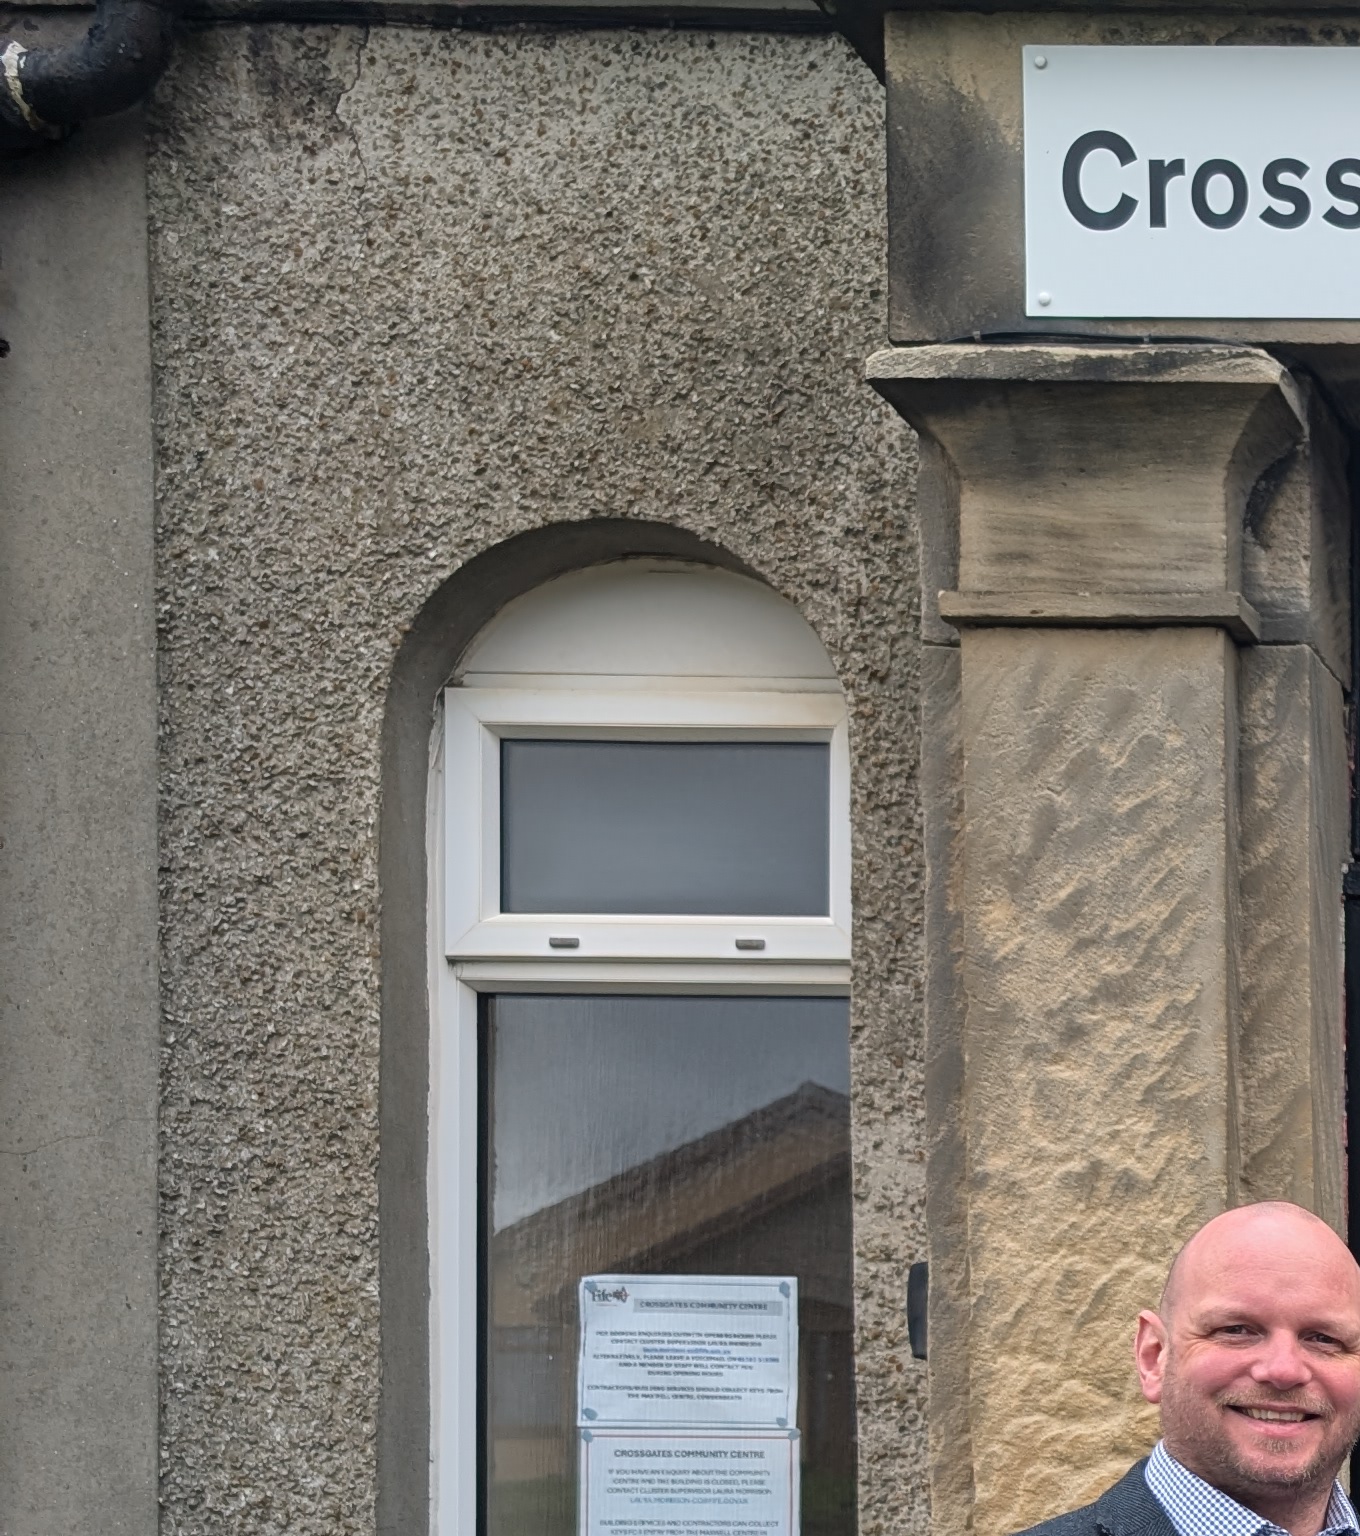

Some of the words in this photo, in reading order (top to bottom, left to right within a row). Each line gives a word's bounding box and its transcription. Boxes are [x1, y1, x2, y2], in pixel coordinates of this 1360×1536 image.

[613, 1449, 674, 1458] CROSSGATES
[674, 1450, 729, 1459] COMMUNITY
[730, 1450, 766, 1459] CENTRE
